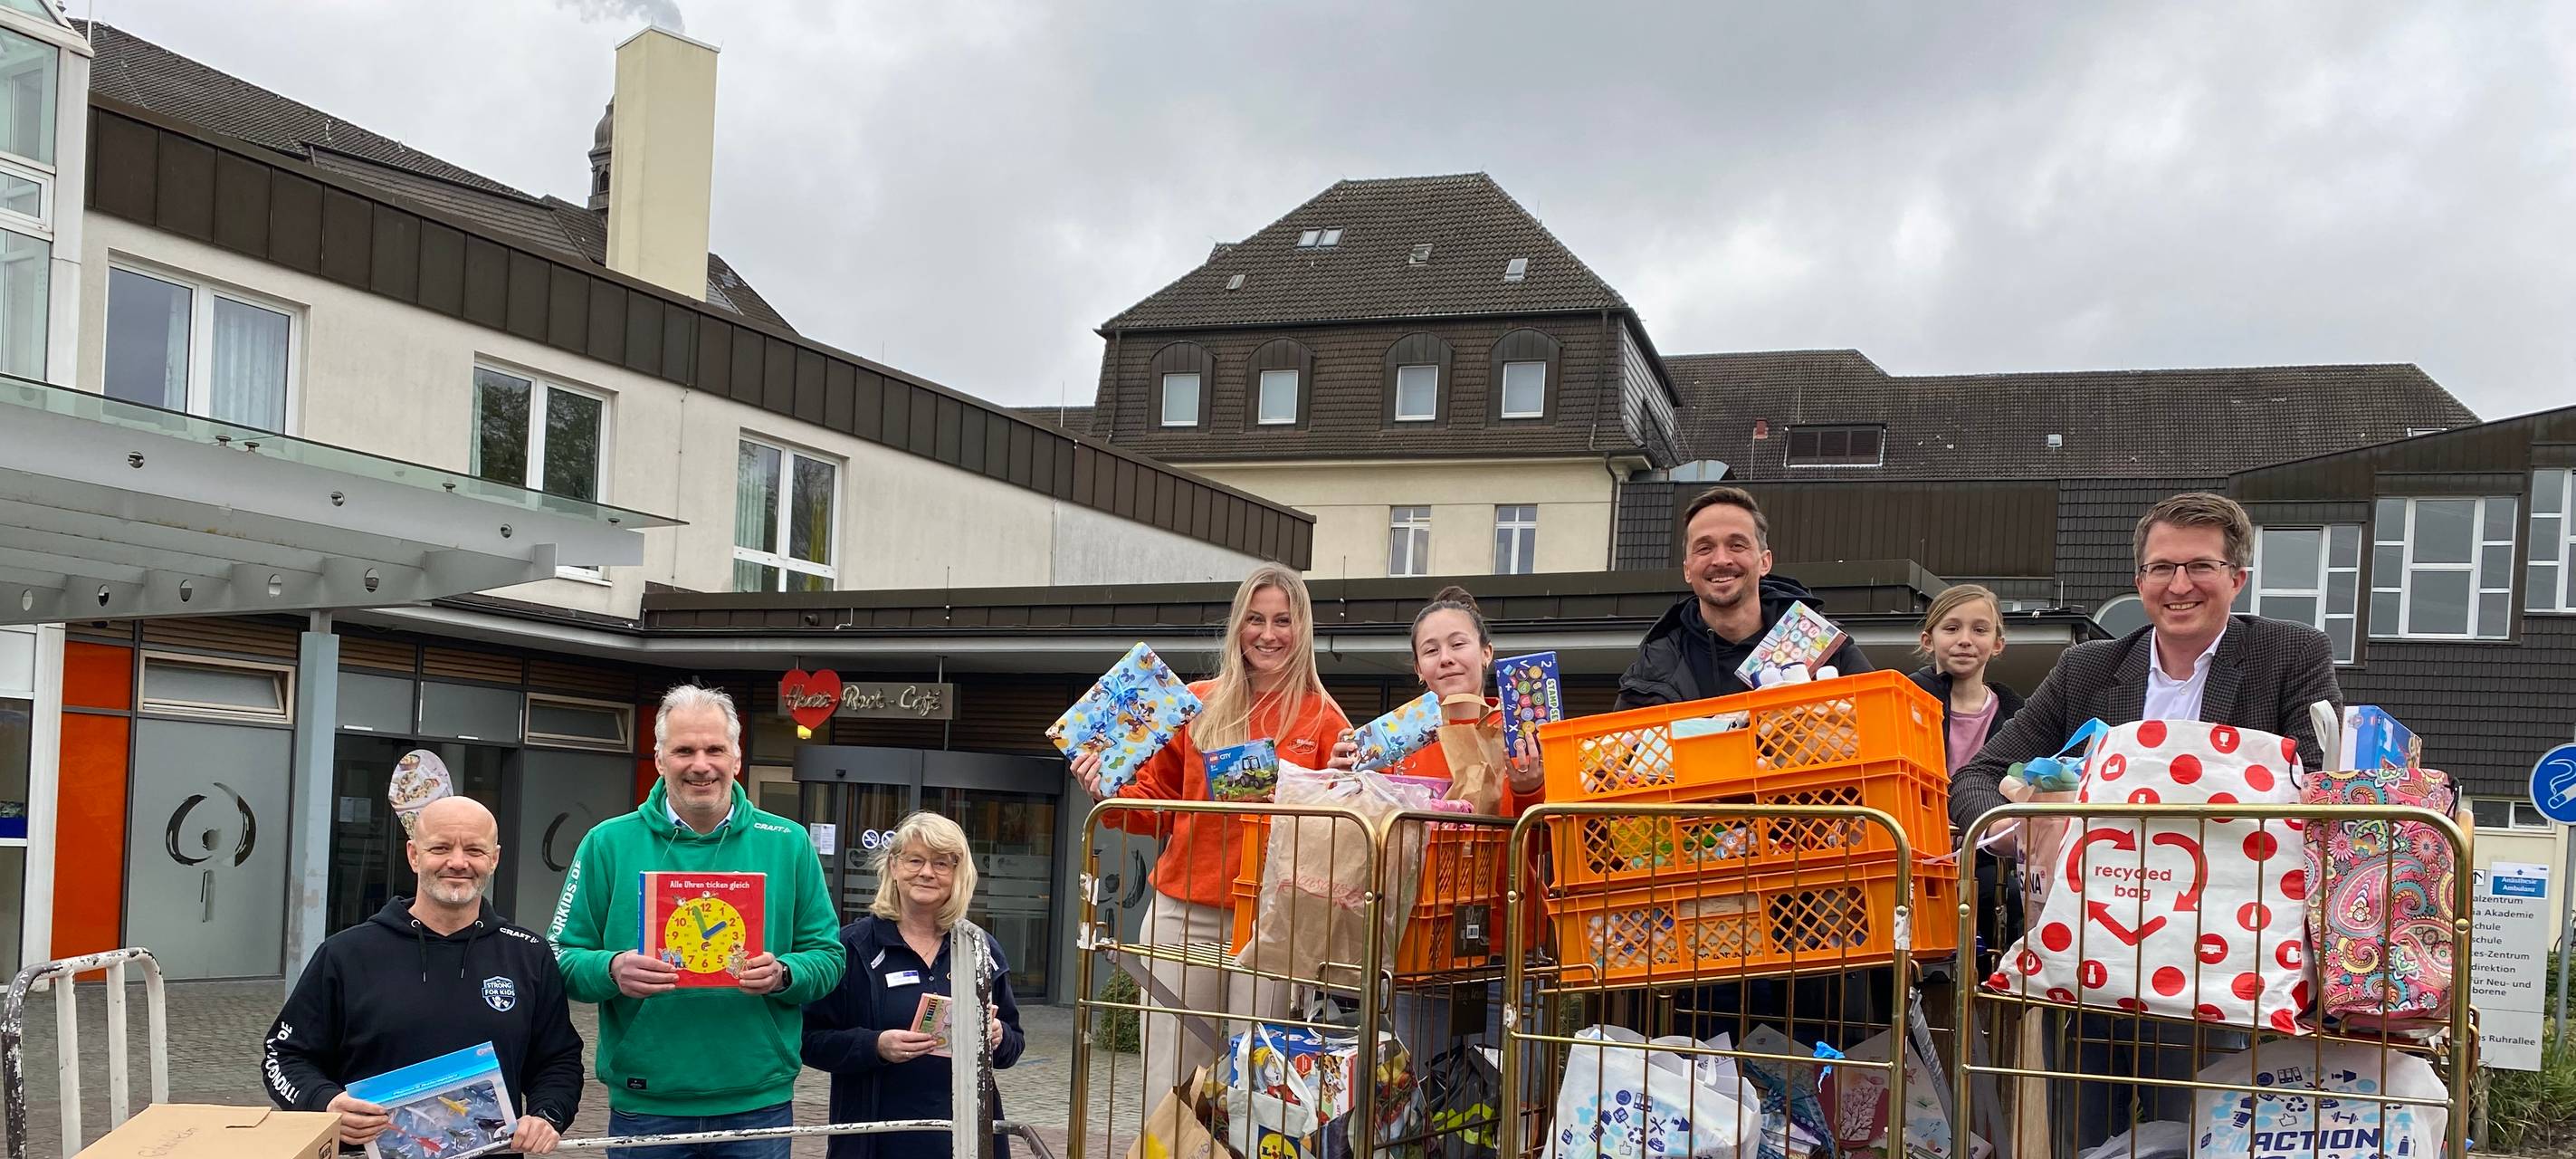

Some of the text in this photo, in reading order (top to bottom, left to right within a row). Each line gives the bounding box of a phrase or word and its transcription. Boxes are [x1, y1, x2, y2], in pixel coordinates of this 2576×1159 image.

[1547, 679, 1559, 708] STAMP
[754, 822, 784, 832] CRAFT
[2094, 866, 2171, 881] recycled
[670, 880, 682, 888] Alle
[706, 880, 728, 888] ticken
[730, 880, 749, 891] gleich
[2114, 885, 2151, 901] bag
[2473, 895, 2524, 905] alzentrum
[701, 903, 711, 913] 12
[720, 907, 725, 915] 1
[2485, 909, 2534, 919] Akademie
[674, 917, 687, 927] 10
[730, 917, 736, 927] 2
[499, 927, 531, 941] CRAFT
[672, 931, 679, 940] 9
[732, 932, 739, 940] 3
[2472, 936, 2503, 944] schule
[688, 955, 695, 964] 7
[717, 955, 723, 963] 5
[2471, 951, 2530, 960] es-Zentrum
[701, 959, 708, 968] 6
[2471, 963, 2516, 973] direktion
[2486, 979, 2509, 987] Neu-
[500, 989, 516, 997] KIDS
[2472, 987, 2507, 996] borene
[2488, 1035, 2536, 1046] Ruhrallee
[2248, 1127, 2381, 1152] ACTION
